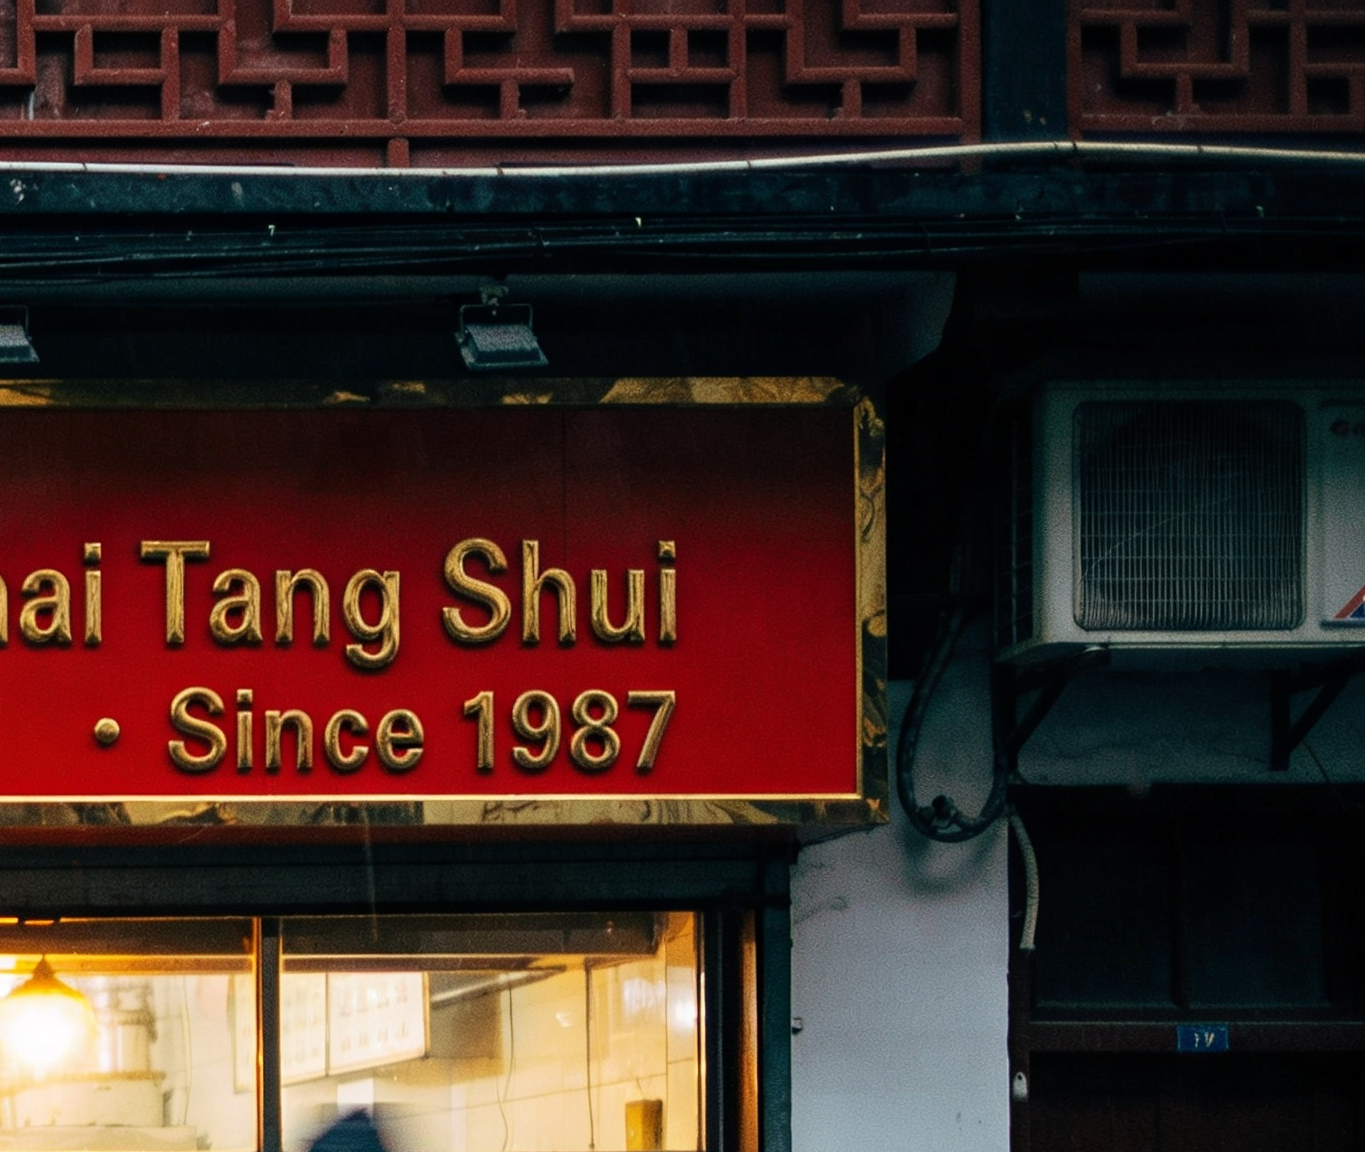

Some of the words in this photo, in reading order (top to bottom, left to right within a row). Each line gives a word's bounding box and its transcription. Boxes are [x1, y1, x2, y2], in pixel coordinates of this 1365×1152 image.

[140, 540, 401, 670] Tang
[442, 537, 678, 644] Shui
[168, 686, 425, 771] Since
[463, 689, 677, 770] 1987
